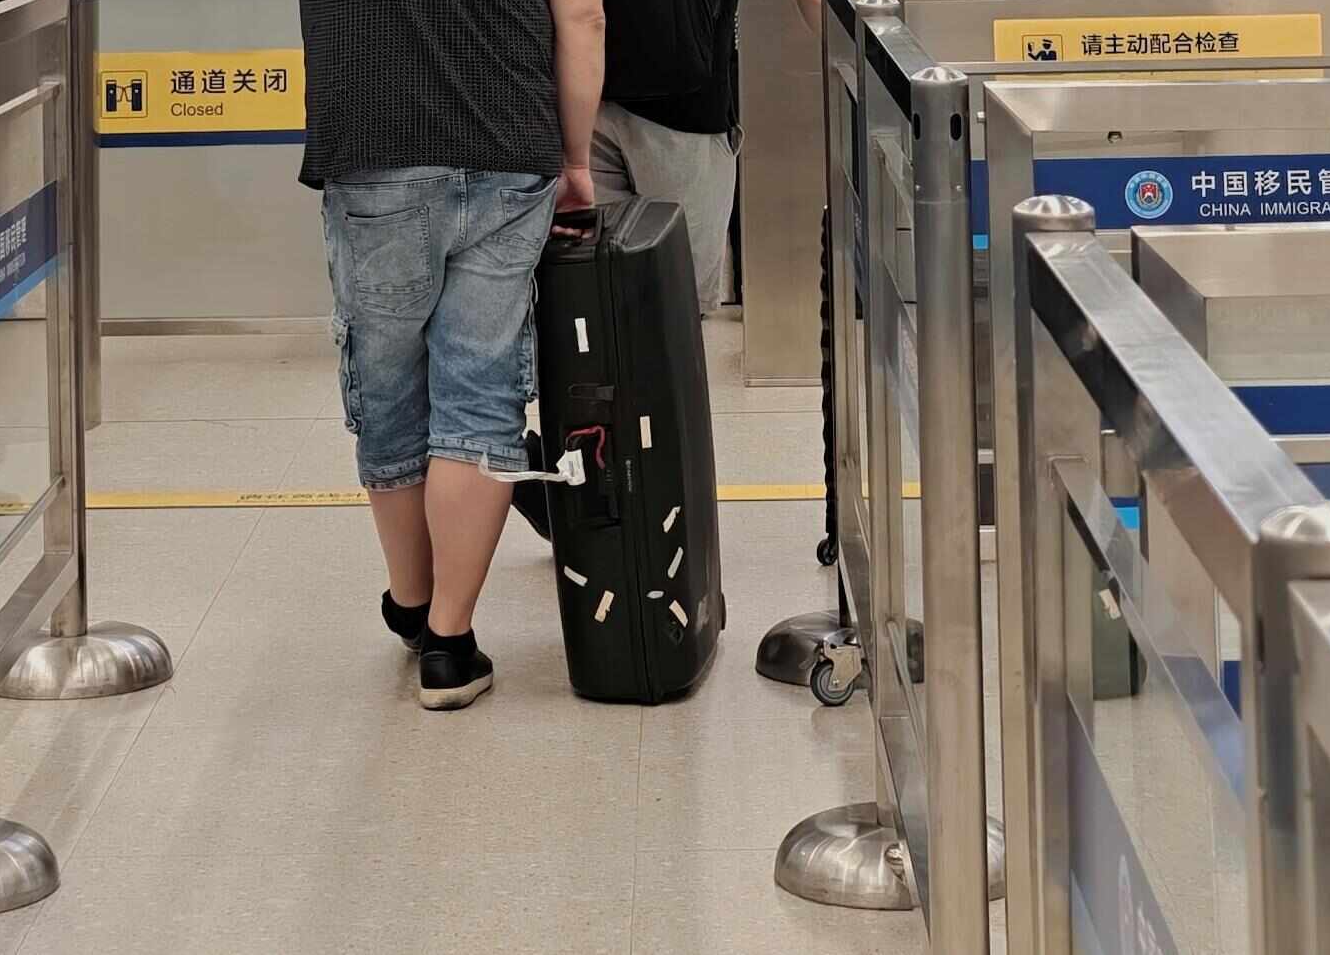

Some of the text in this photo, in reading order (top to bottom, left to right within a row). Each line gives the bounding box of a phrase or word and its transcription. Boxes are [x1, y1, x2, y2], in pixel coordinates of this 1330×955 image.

[1081, 31, 1240, 56] 请主动配合检查
[170, 68, 287, 94] 通道关闭
[170, 102, 224, 117] Closed
[1199, 202, 1252, 217] CHINA
